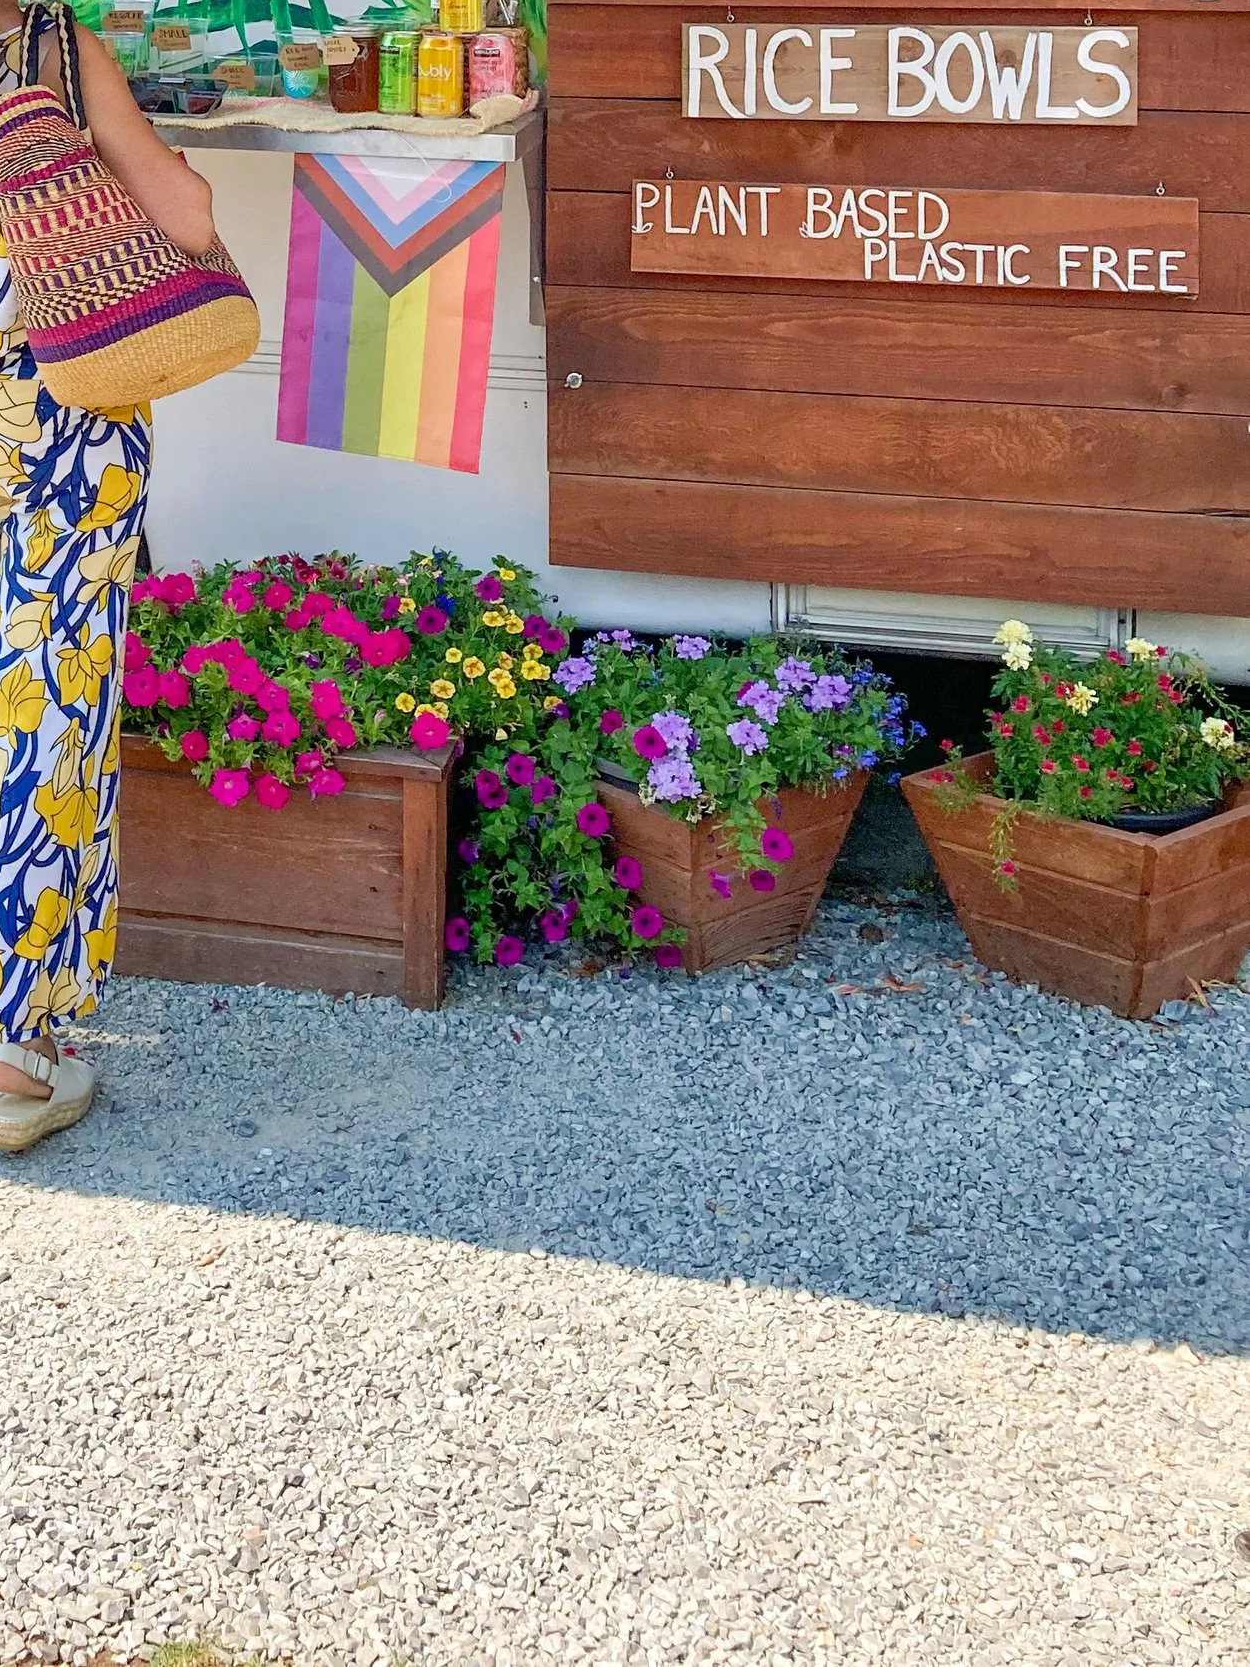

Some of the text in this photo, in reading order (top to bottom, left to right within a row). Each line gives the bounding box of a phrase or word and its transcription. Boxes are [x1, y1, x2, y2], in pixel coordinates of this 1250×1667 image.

[687, 25, 1132, 121] RICE BOWLS
[634, 182, 950, 240] PLANT BASED
[863, 238, 1188, 293] PLASTIC FREE
